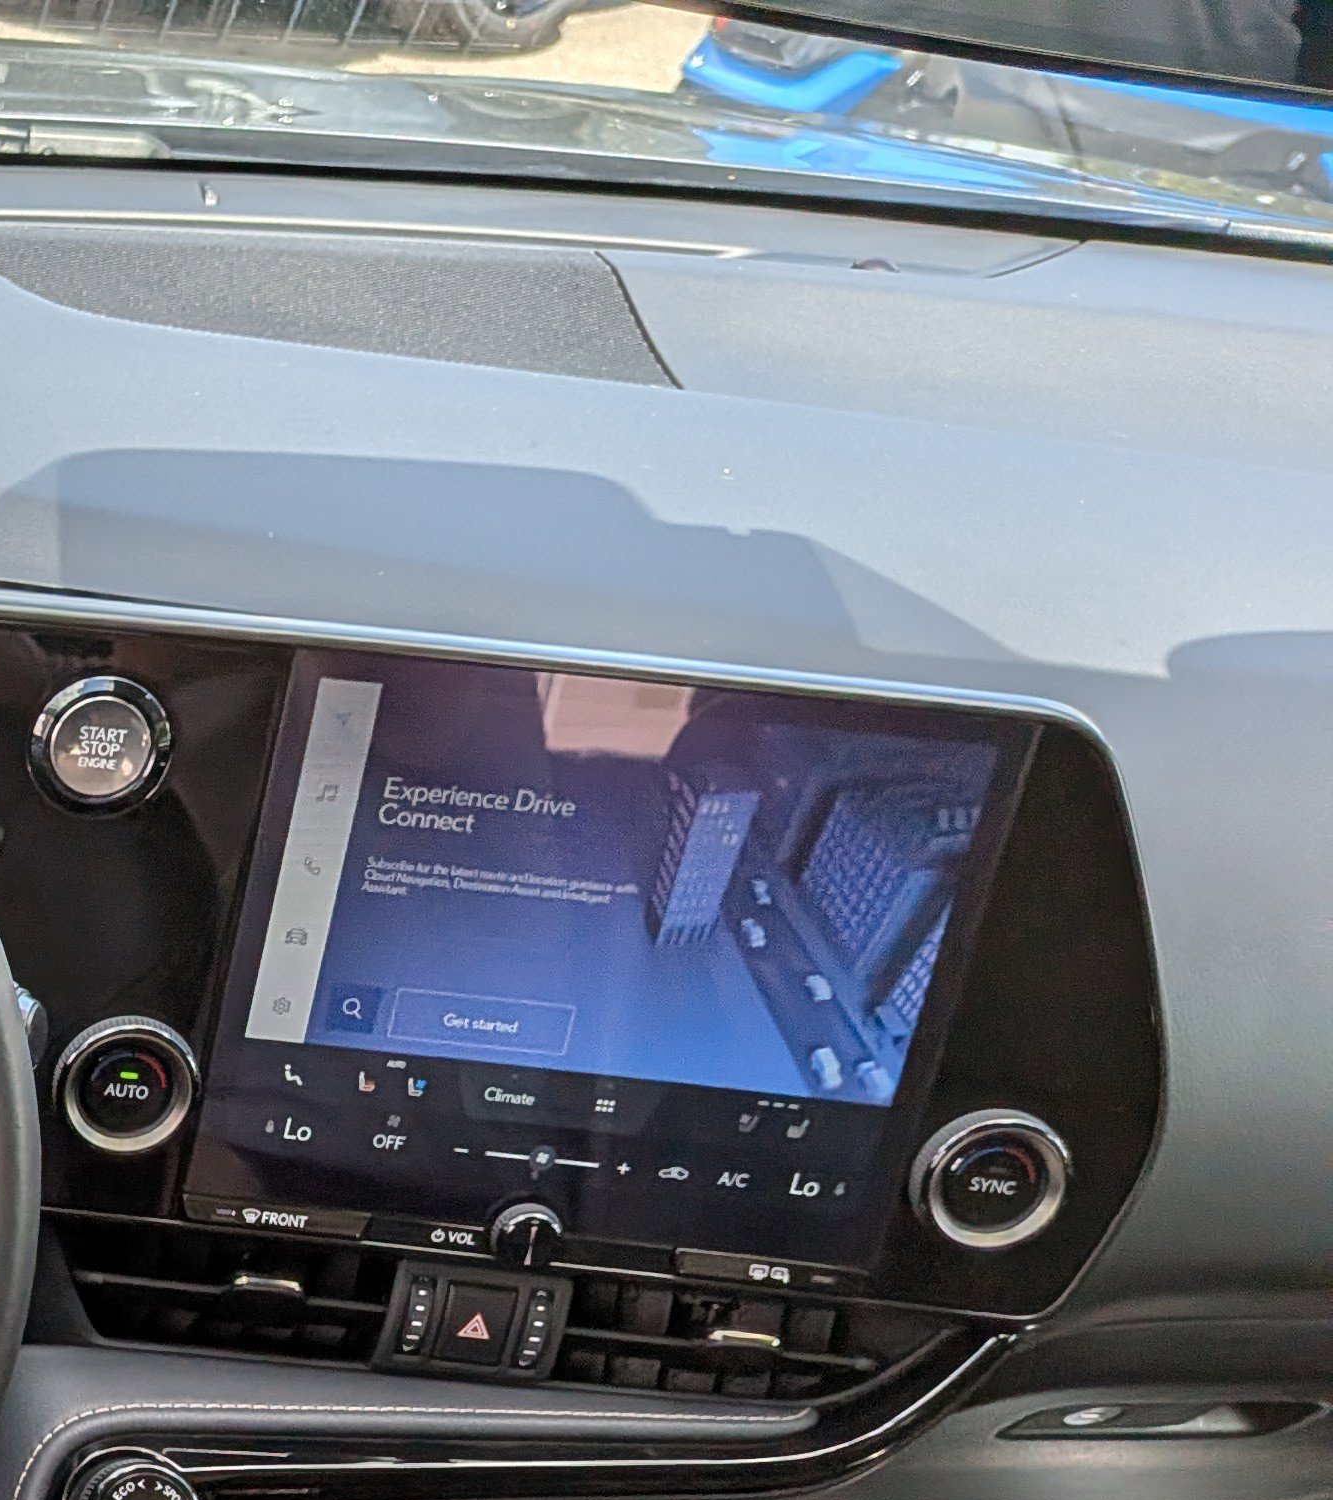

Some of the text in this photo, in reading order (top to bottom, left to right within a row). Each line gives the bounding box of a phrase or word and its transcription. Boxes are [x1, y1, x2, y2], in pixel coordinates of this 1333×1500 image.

[78, 725, 129, 744] START
[80, 740, 122, 758] STOP
[77, 756, 118, 771] ENGINE
[382, 776, 576, 818] Experience Drive
[378, 802, 476, 834] Connect
[442, 1011, 519, 1034] Get started
[103, 1082, 150, 1101] AUTO
[483, 1085, 536, 1107] Climate
[282, 1116, 313, 1142] Lo
[372, 1132, 408, 1151] OFF
[716, 1170, 750, 1190] A/C
[789, 1173, 822, 1198] Lo
[967, 1176, 1019, 1197] SYNC
[260, 1212, 309, 1230] FRONT
[447, 1230, 476, 1247] VOL
